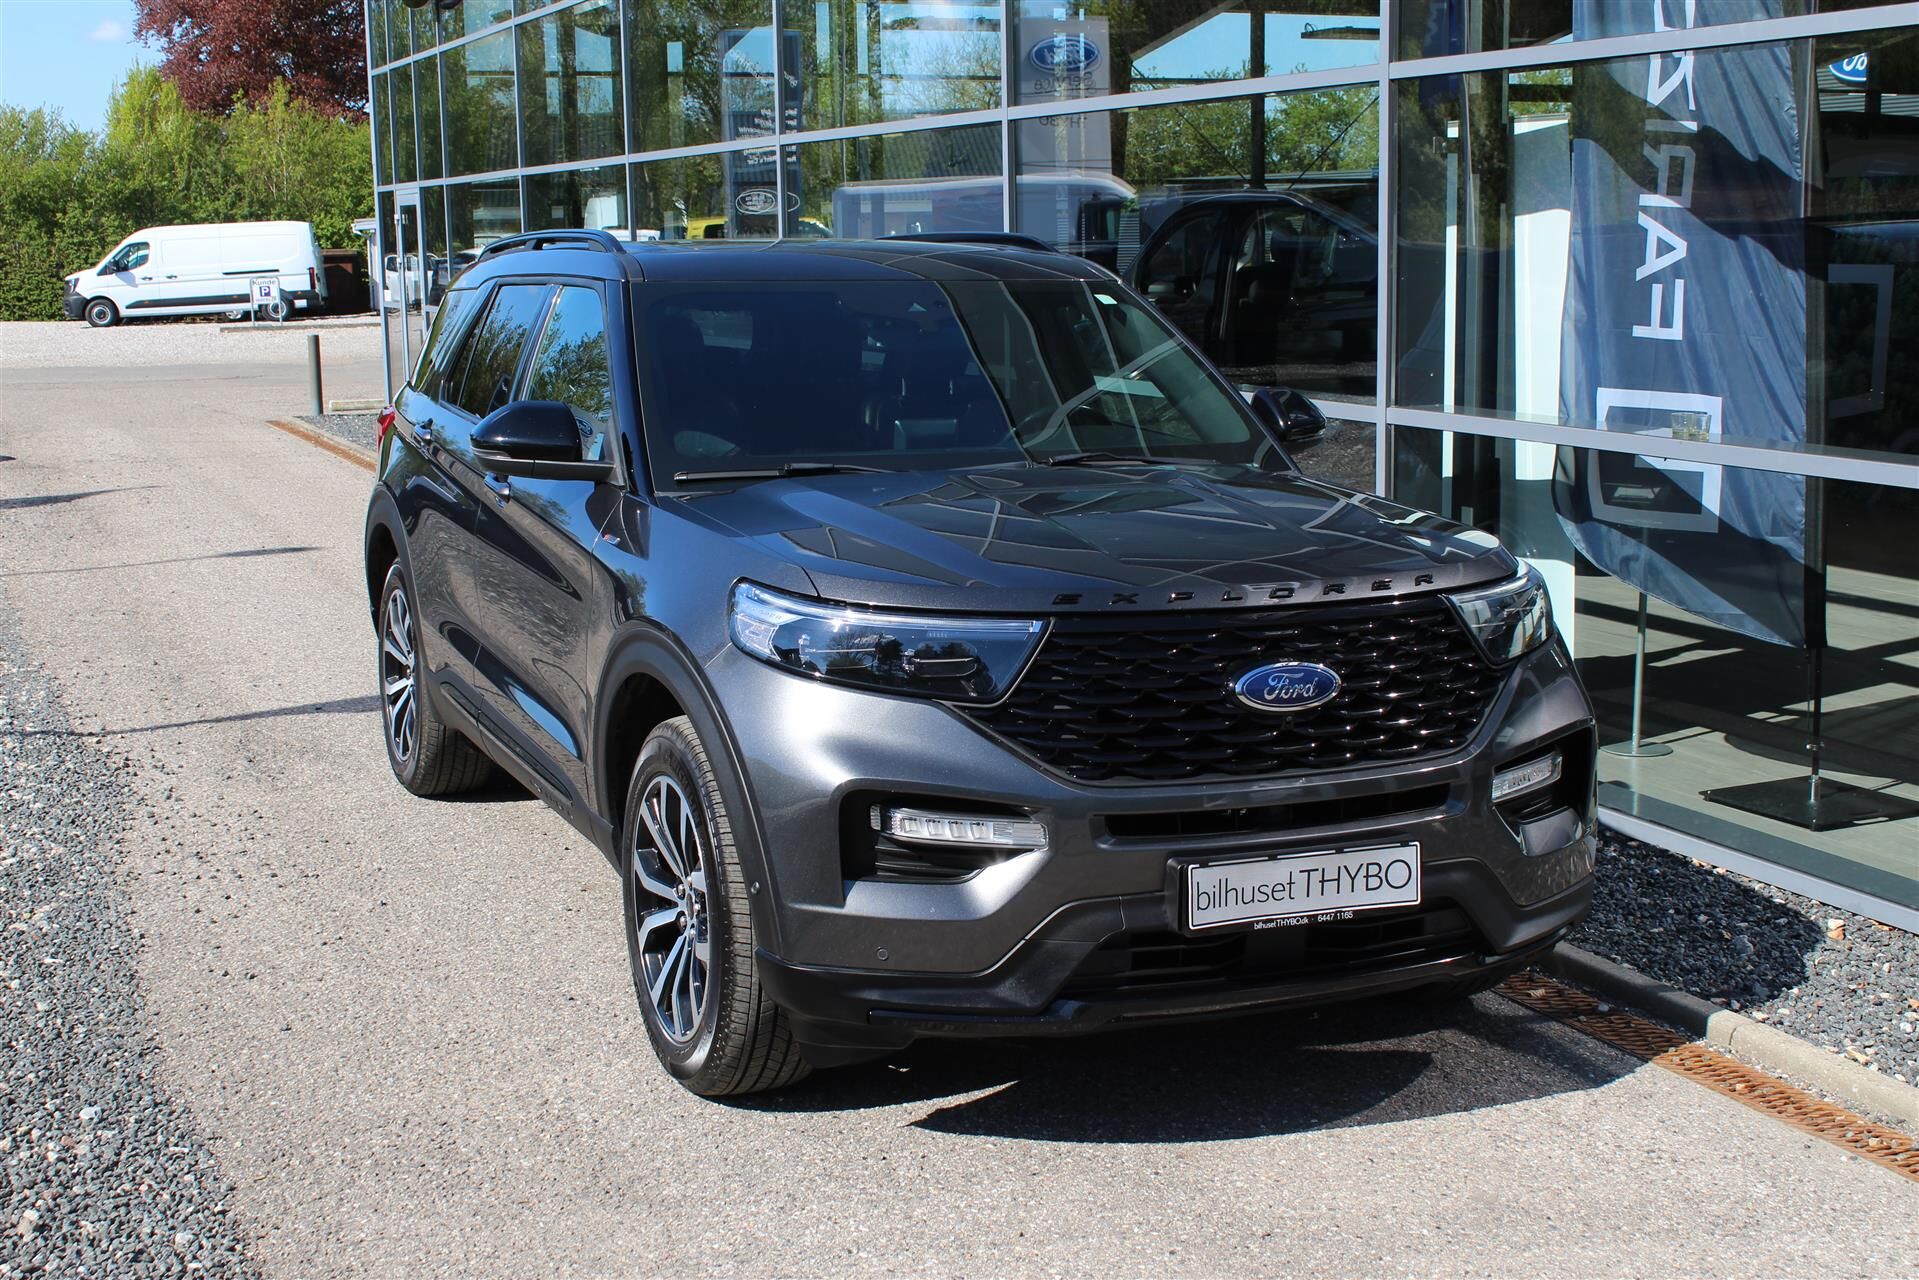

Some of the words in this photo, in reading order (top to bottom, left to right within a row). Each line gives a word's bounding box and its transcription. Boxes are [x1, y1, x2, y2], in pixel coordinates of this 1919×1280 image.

[1052, 572, 1434, 605] EXPLORER
[1263, 672, 1318, 701] Ford
[1196, 871, 1295, 912] bilhuset
[1299, 859, 1412, 898] THYBO
[1317, 913, 1334, 923] 6447
